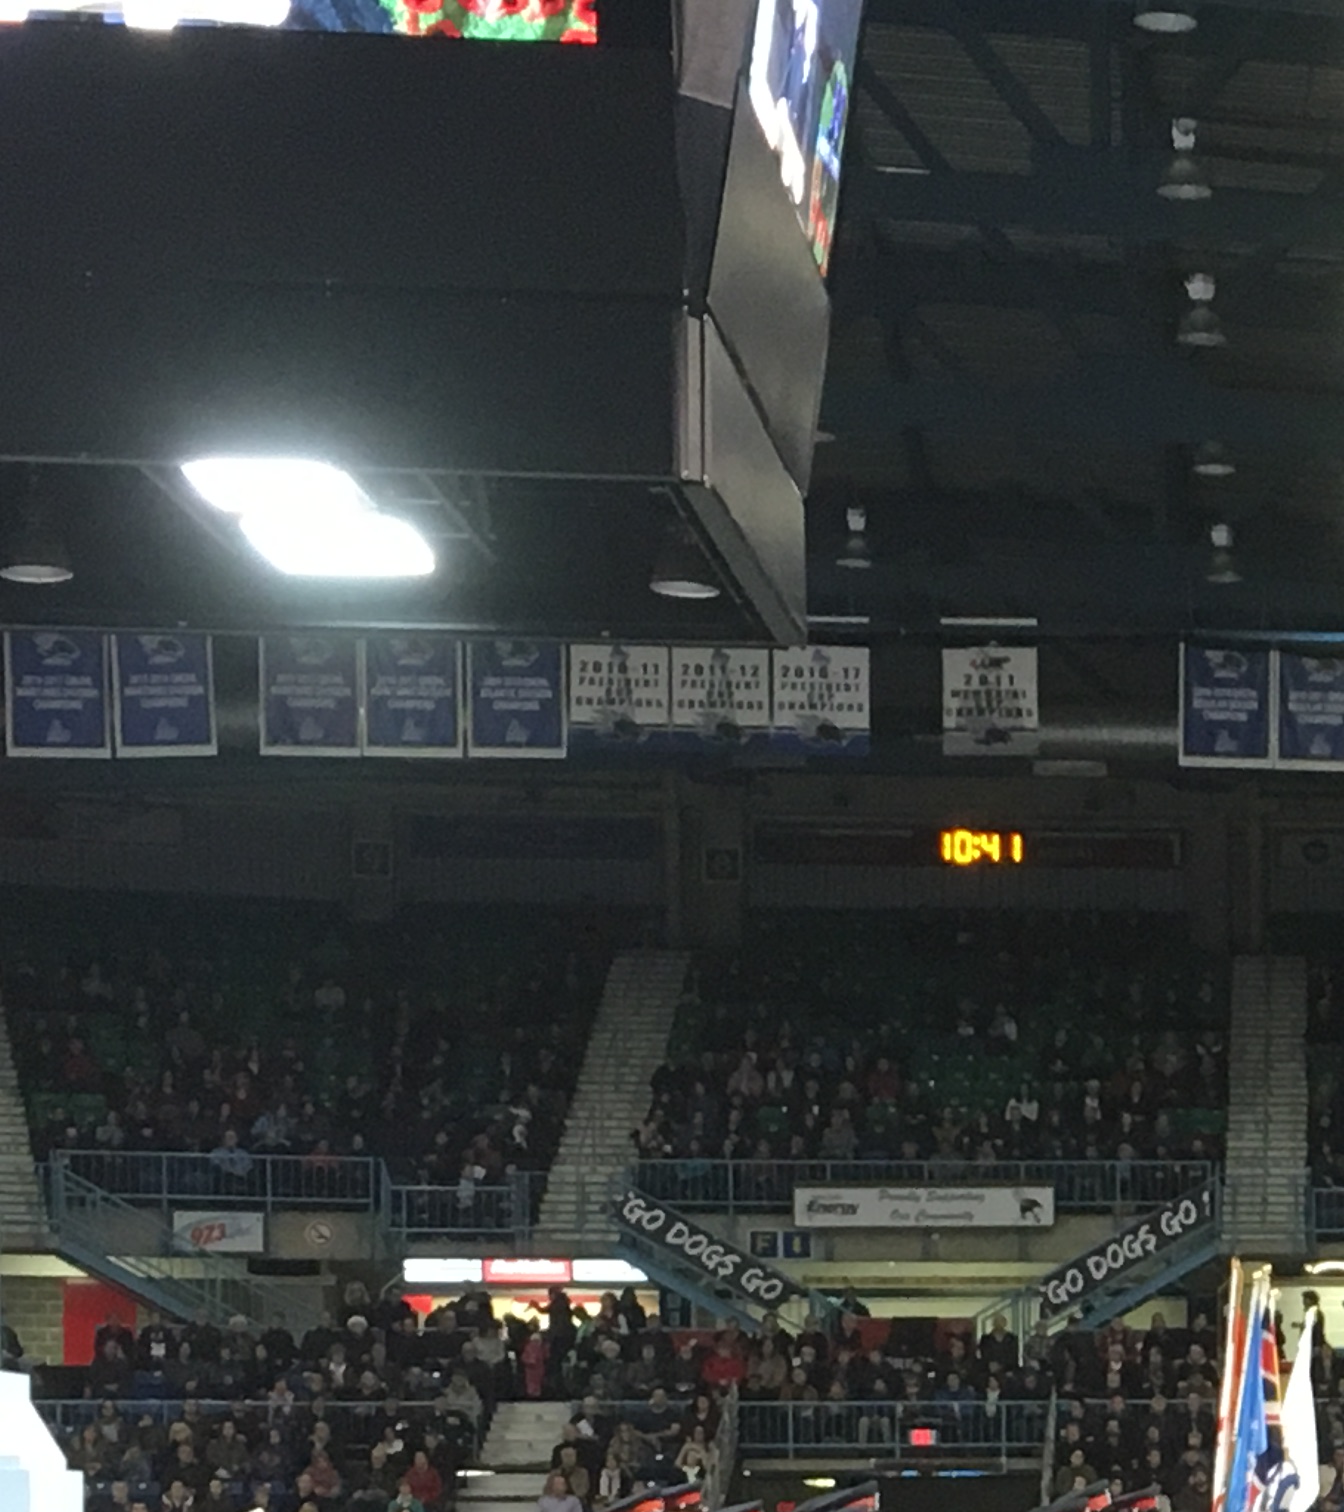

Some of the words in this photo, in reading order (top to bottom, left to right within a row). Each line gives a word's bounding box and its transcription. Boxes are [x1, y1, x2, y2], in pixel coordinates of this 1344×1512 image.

[942, 829, 1024, 865] 10:41
[622, 1198, 666, 1231] GO
[665, 1221, 742, 1279] DOGS
[740, 1268, 783, 1300] GO
[1046, 1268, 1084, 1304] GO
[1087, 1224, 1157, 1280] DOGS
[1160, 1199, 1198, 1236] GO
